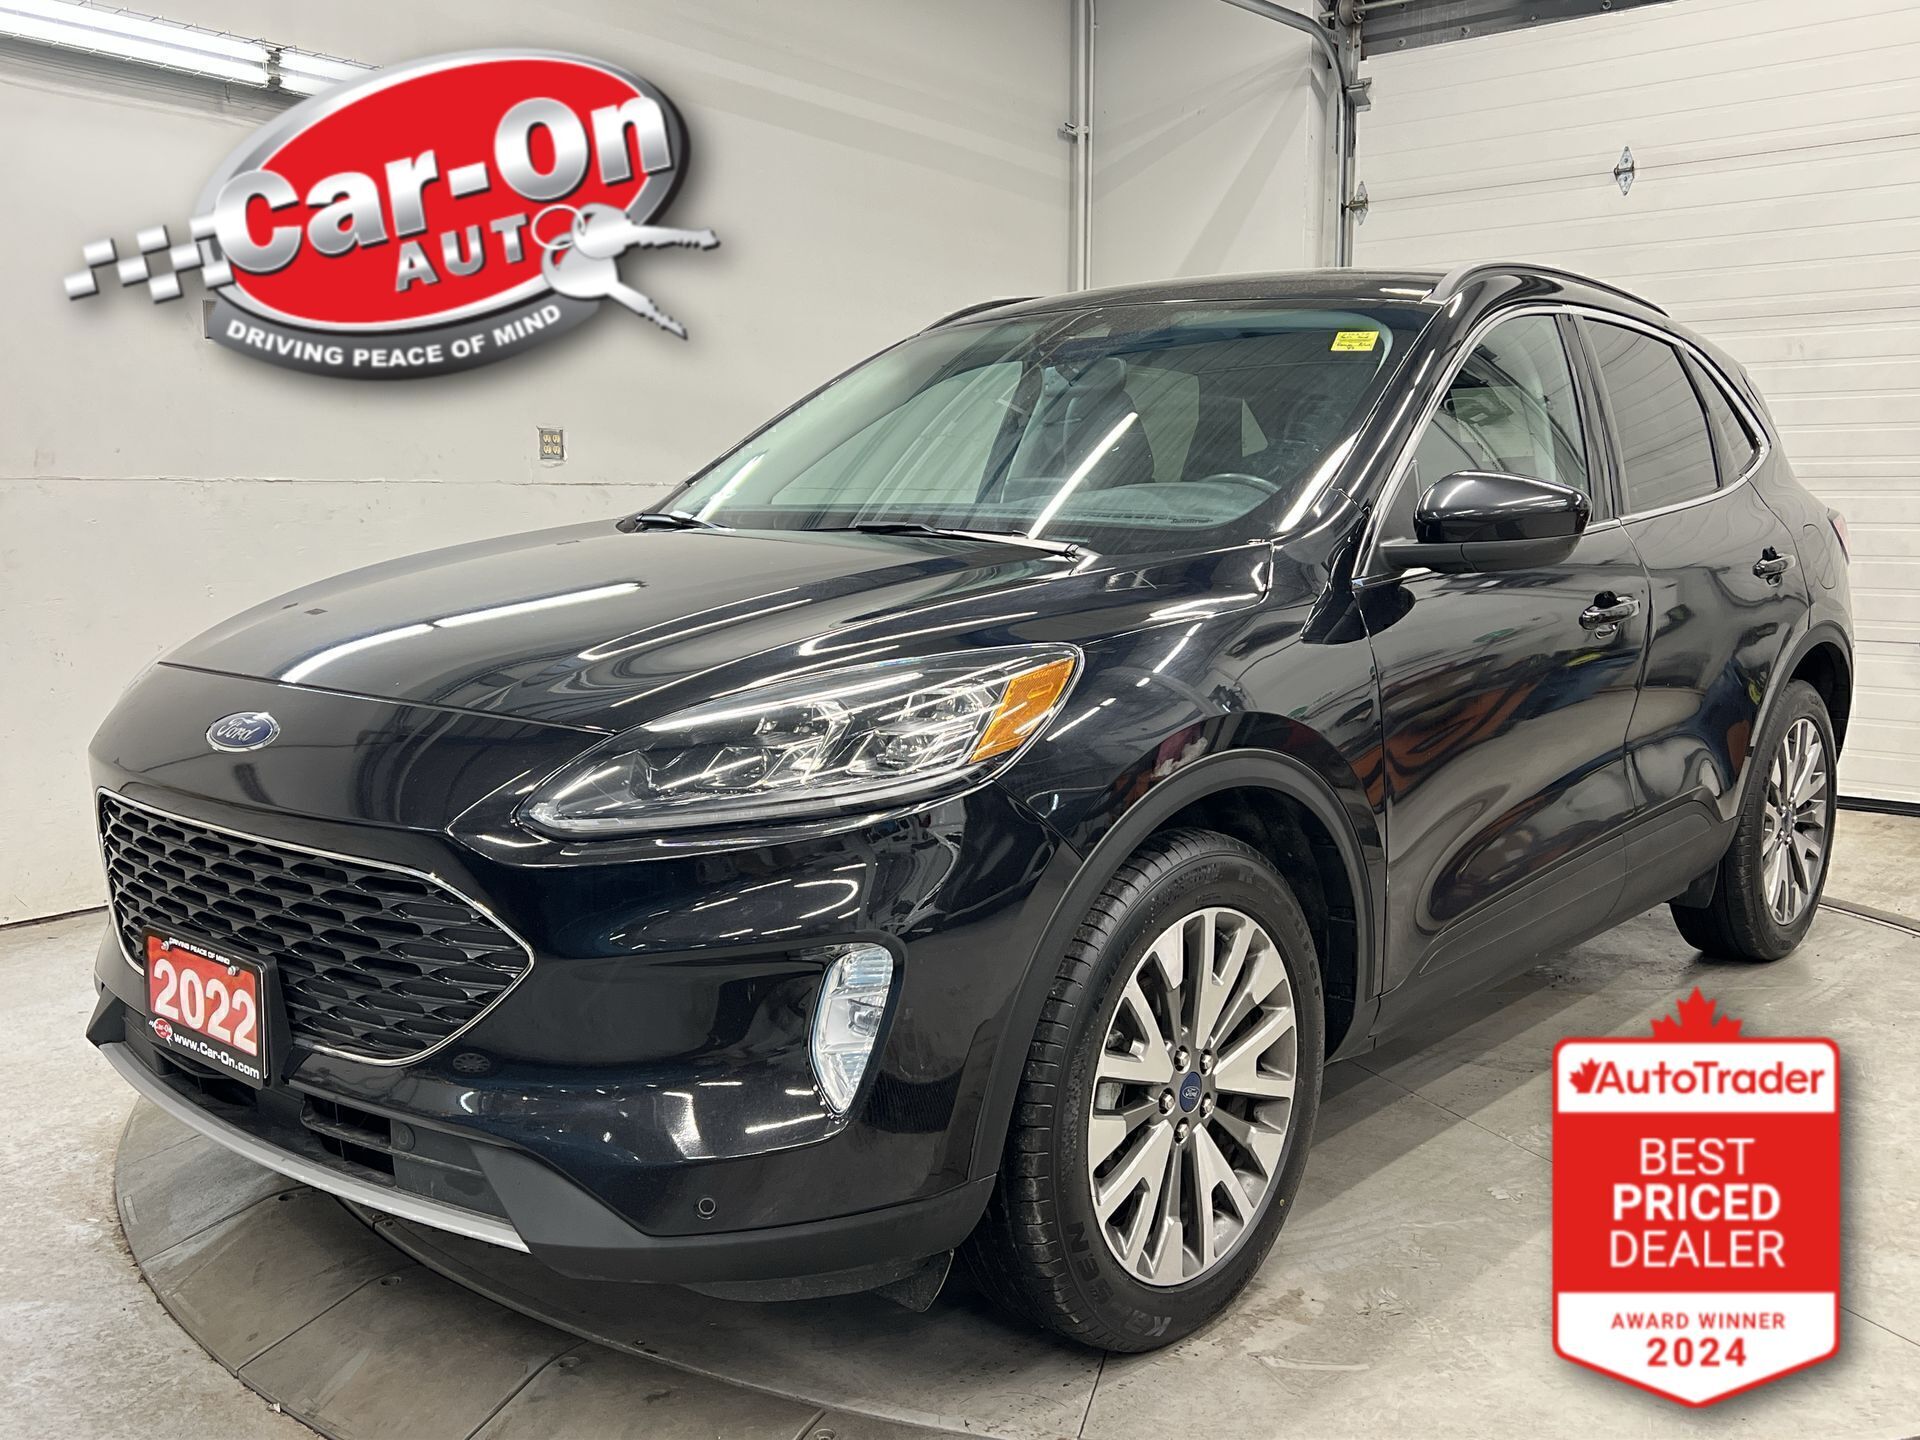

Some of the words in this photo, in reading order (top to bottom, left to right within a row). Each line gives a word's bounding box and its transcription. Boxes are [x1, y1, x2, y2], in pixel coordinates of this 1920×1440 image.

[217, 717, 261, 741] Ford
[153, 958, 257, 1056] 2022
[173, 1033, 260, 1079] www.Car-On.com
